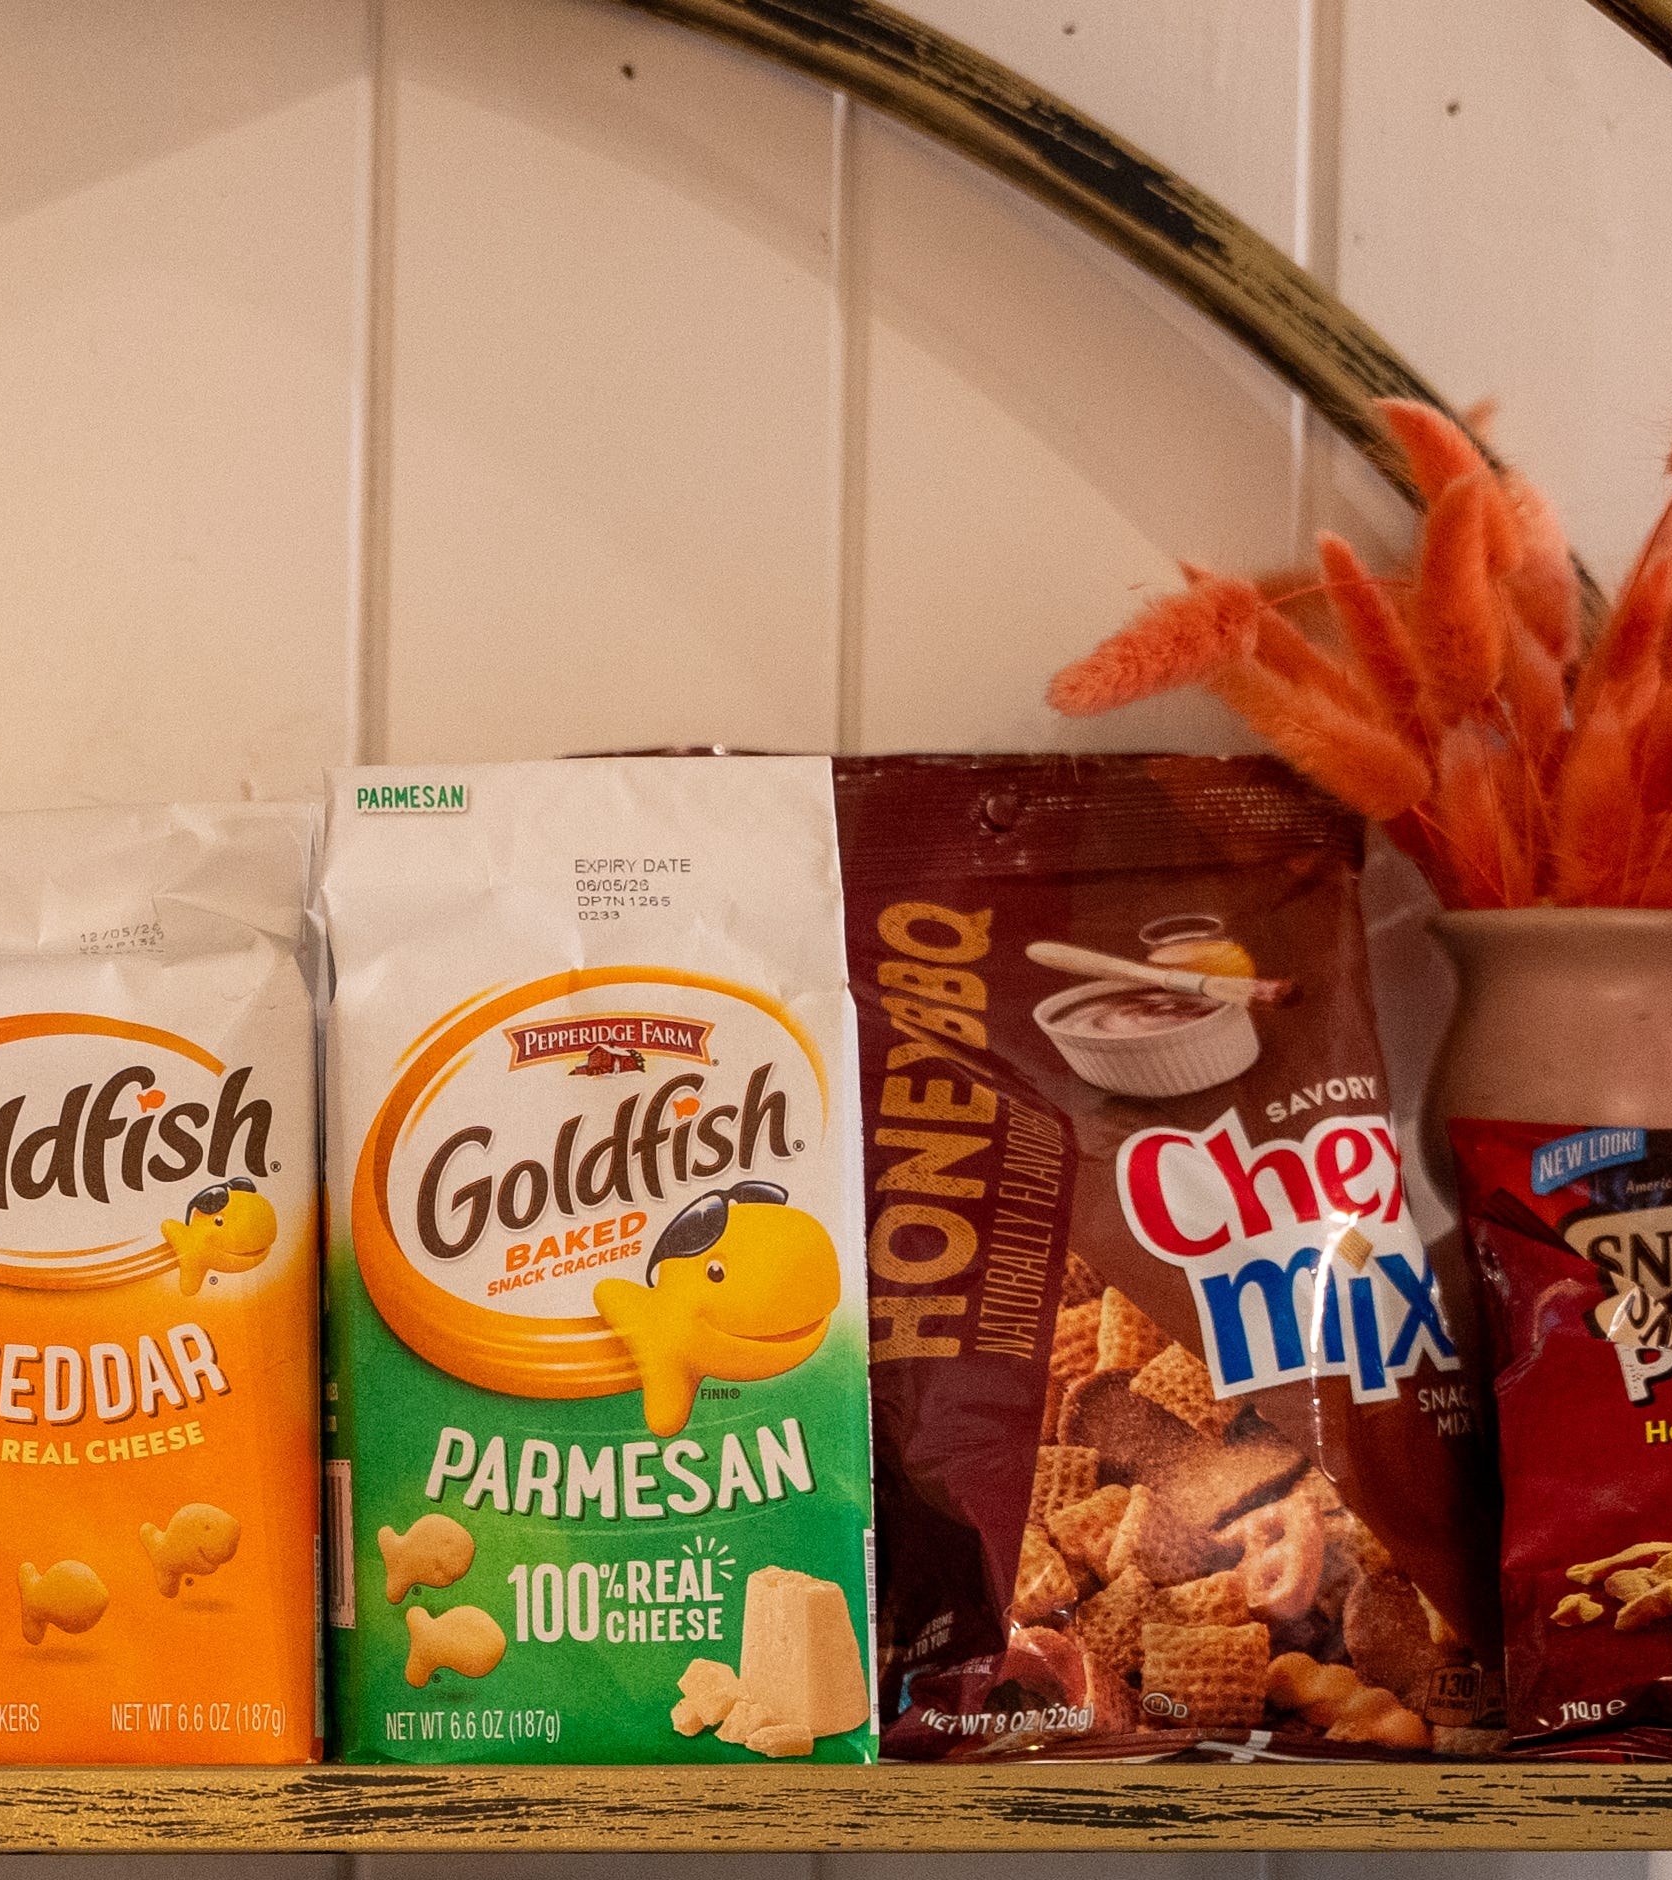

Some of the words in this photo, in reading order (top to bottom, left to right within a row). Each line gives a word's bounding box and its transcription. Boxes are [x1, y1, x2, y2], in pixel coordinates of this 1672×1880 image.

[357, 785, 464, 809] PARMESAN
[575, 859, 636, 874] EXPIRY
[642, 859, 691, 873] DATE
[576, 880, 649, 892] 06/05/26
[877, 901, 993, 1050] BBQ
[524, 1024, 636, 1052] PEPPERIDGE
[641, 1023, 693, 1048] FARM
[1266, 1075, 1379, 1124] SAVORY
[417, 1063, 791, 1260] Goldfish
[1539, 1142, 1583, 1180] NEW
[1588, 1131, 1641, 1169] LOOK!
[868, 1015, 998, 1363] HONEY
[505, 1212, 647, 1272] BAKED
[487, 1266, 548, 1296] SNACK
[551, 1241, 642, 1278] CRACKERS
[975, 1208, 1053, 1359] NATURALLY
[1200, 1246, 1459, 1391] mix
[424, 1417, 816, 1521] PARMESAN
[628, 1559, 723, 1603] REAL
[607, 1608, 722, 1642] CHEESE
